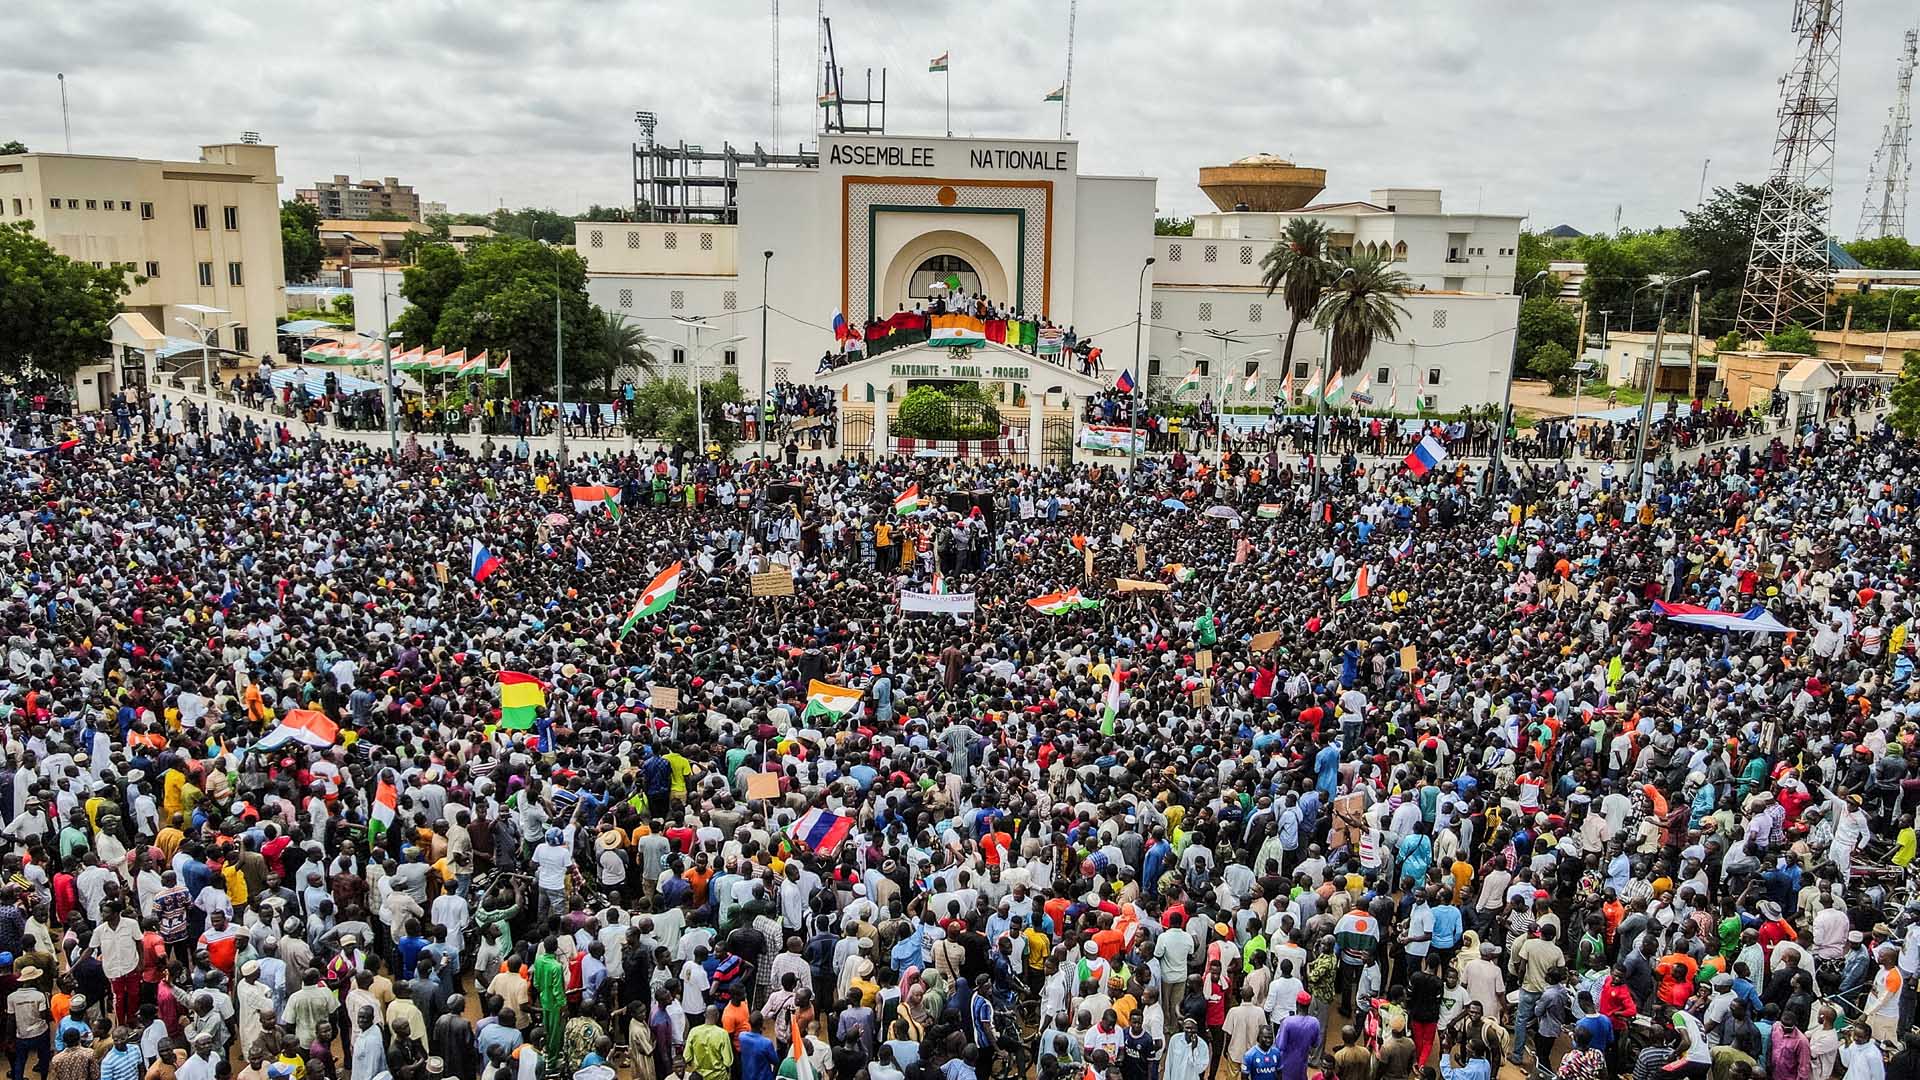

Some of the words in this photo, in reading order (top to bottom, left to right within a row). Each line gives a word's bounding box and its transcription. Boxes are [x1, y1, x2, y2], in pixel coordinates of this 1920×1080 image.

[830, 144, 935, 167] ASSEMBLEE
[970, 149, 1067, 171] NATIONALE
[891, 364, 939, 376] FRATERNITE
[951, 365, 982, 377] TRAVAIL
[992, 366, 1029, 379] PROGRES
[54, 763, 61, 775] 7
